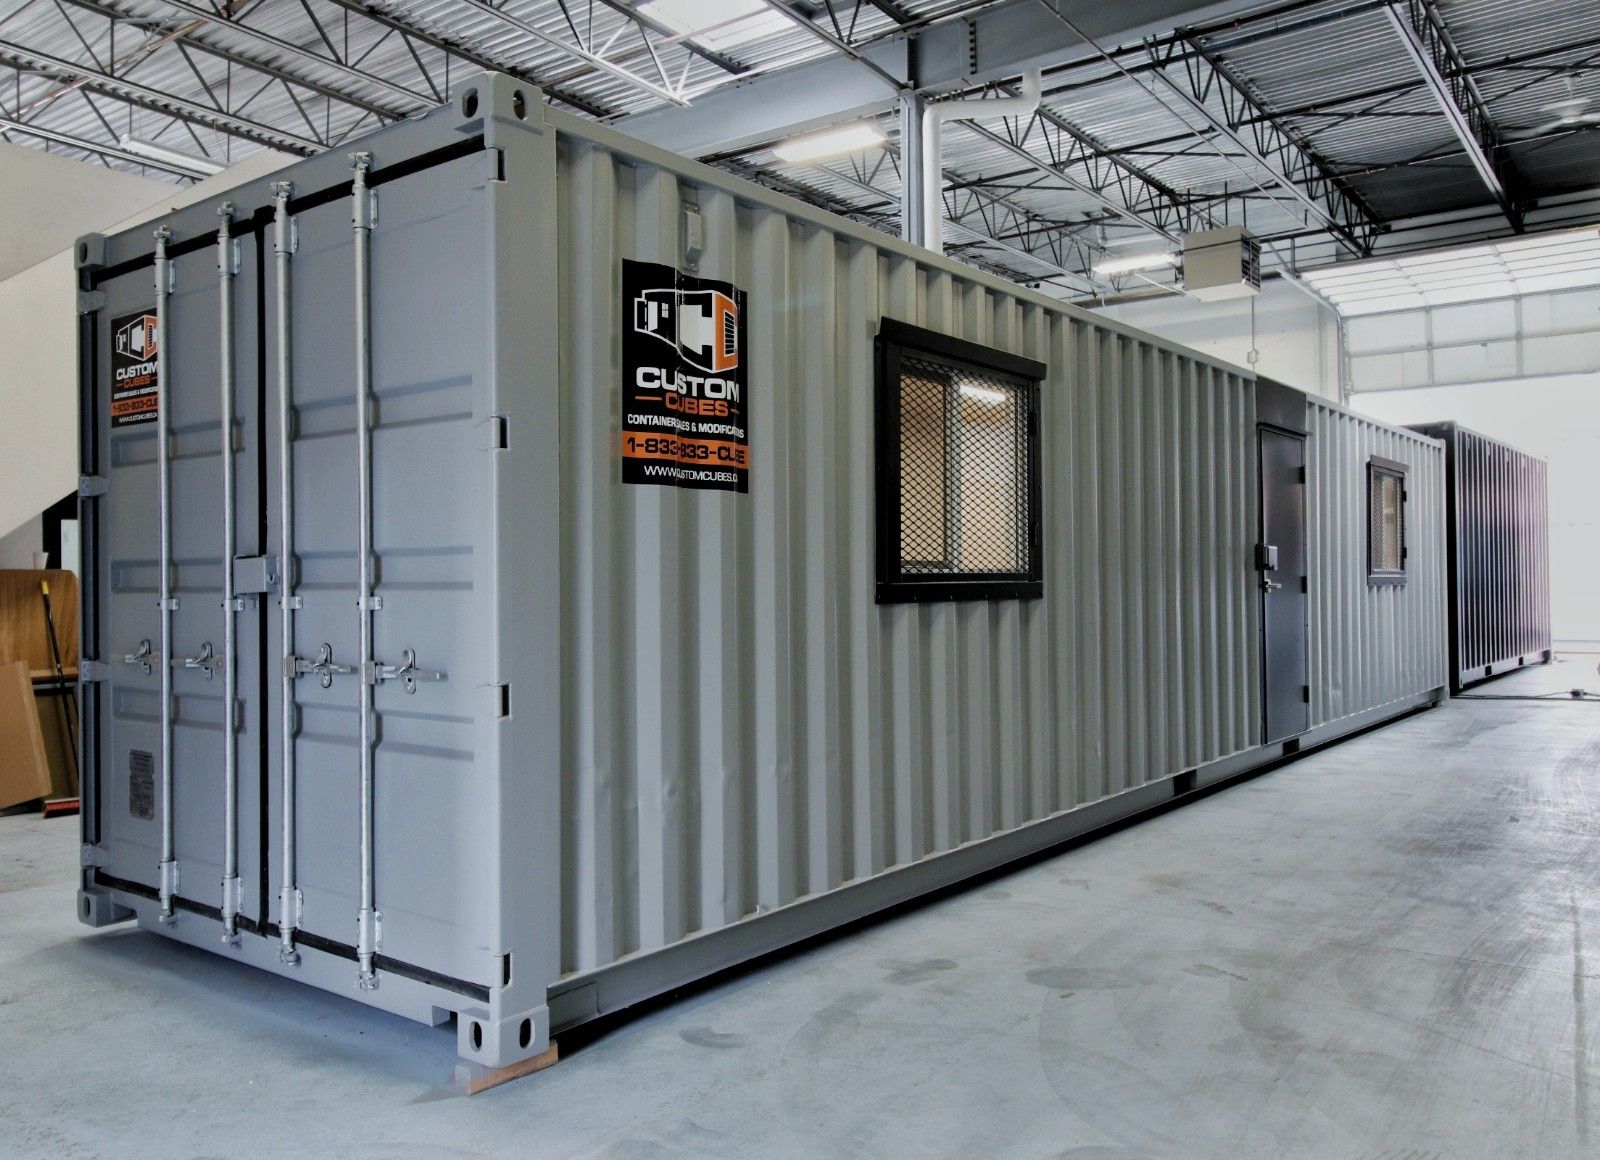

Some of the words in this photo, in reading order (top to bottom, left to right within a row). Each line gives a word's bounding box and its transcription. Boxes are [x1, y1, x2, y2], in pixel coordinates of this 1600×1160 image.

[116, 361, 158, 380] CUSTOM
[124, 375, 151, 388] CUBES
[636, 366, 740, 403] CUSTOM
[665, 391, 729, 417] CUBES
[691, 422, 697, 432] &
